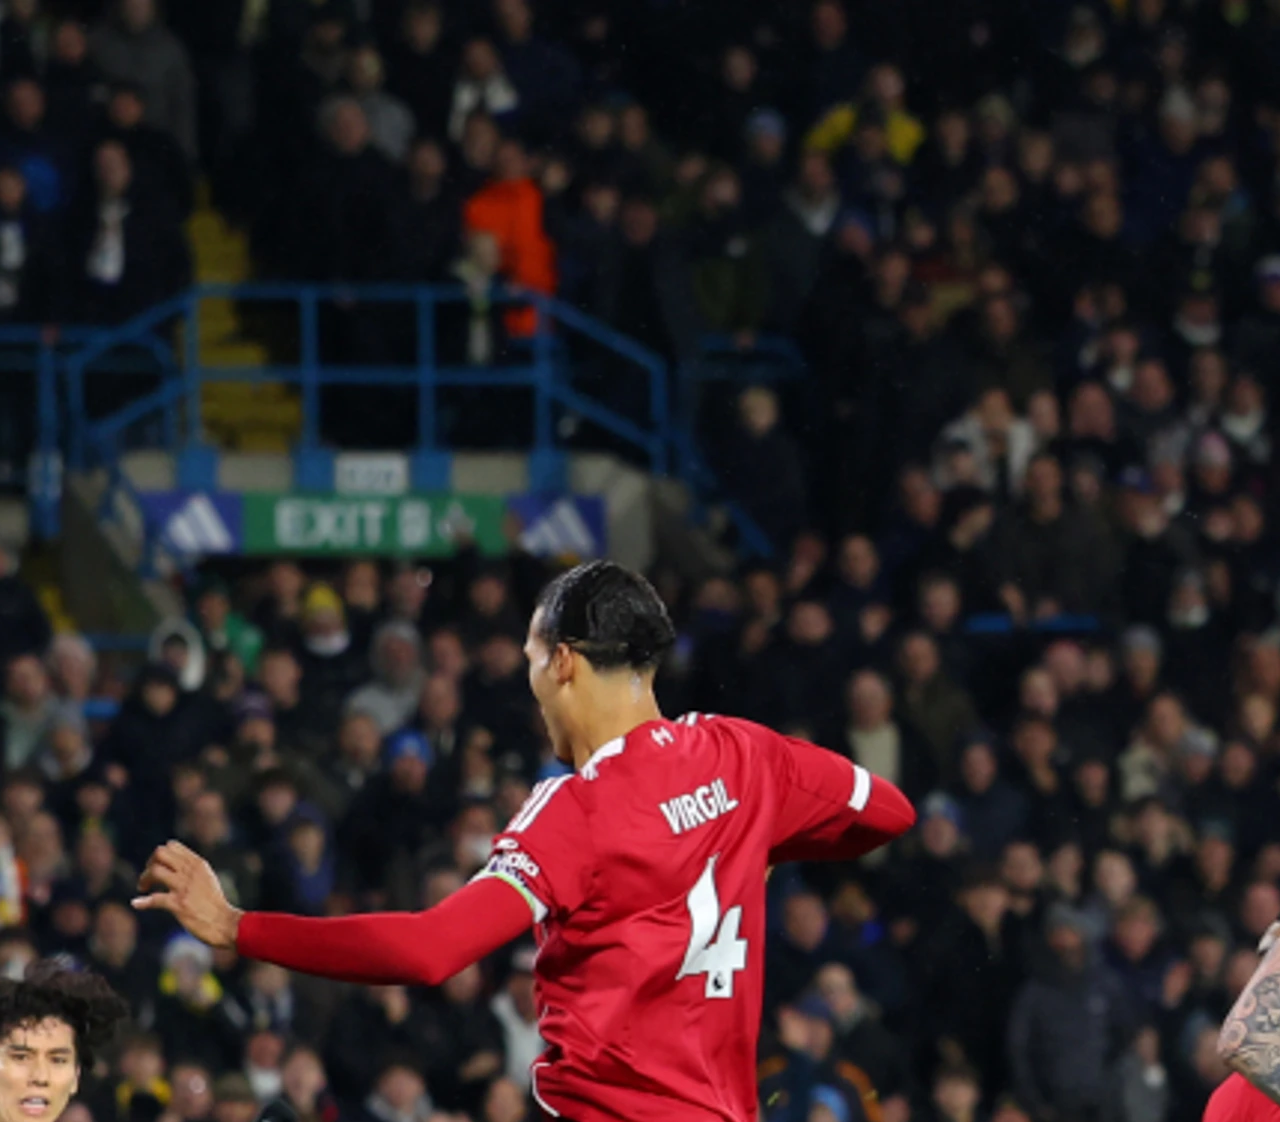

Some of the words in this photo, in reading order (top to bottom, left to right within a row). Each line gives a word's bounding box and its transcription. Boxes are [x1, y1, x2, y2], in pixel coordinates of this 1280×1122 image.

[275, 499, 388, 547] EXIT
[658, 777, 739, 835] VIRGIL
[676, 853, 748, 998] 4
